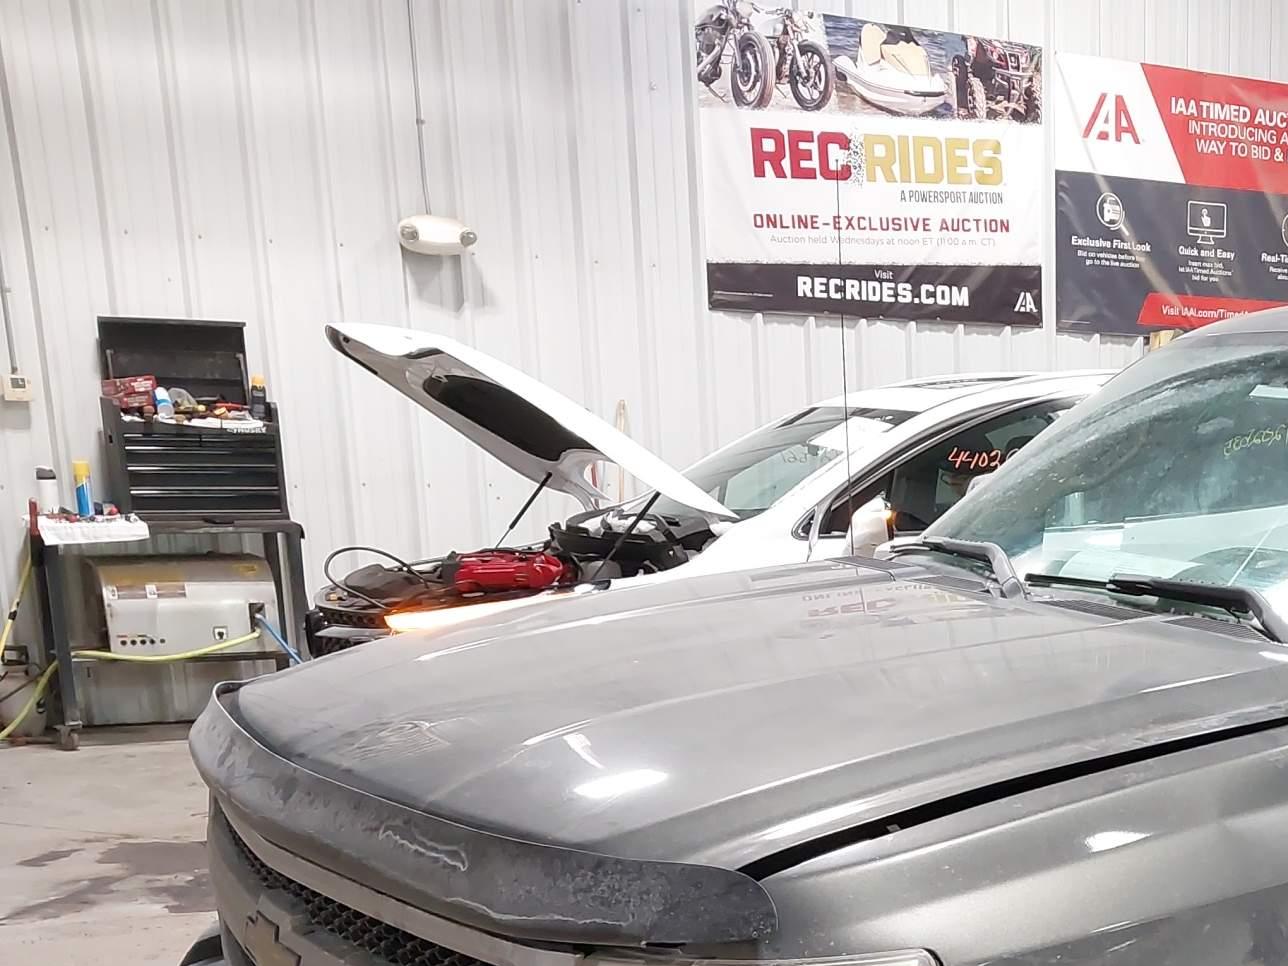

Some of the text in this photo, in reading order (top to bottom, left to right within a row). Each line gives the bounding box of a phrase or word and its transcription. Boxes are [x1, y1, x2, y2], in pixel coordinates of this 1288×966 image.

[1170, 97, 1197, 116] IAA
[1200, 100, 1250, 123] TIMED
[1188, 120, 1276, 145] INTRODUCING
[750, 127, 1004, 186] REC RIDES
[1196, 138, 1226, 155] WAY
[1229, 142, 1248, 157] TO
[1252, 145, 1271, 160] BID
[1274, 147, 1284, 162] &
[900, 190, 1004, 205] A POWERSPORT AUCTION
[753, 213, 1010, 233] ONLINE-EXCLUSIVE AUCTION
[770, 235, 806, 244] Auction
[808, 236, 827, 244] held
[830, 236, 884, 246] Wednesdays
[898, 238, 920, 246] noon
[922, 238, 934, 246] ET
[1071, 236, 1151, 252] Exclusive First Look
[1178, 246, 1235, 261] Quick and Easy
[874, 269, 893, 280] Visit
[797, 276, 970, 307] RECRIDES.COM
[1162, 305, 1179, 316] Visit
